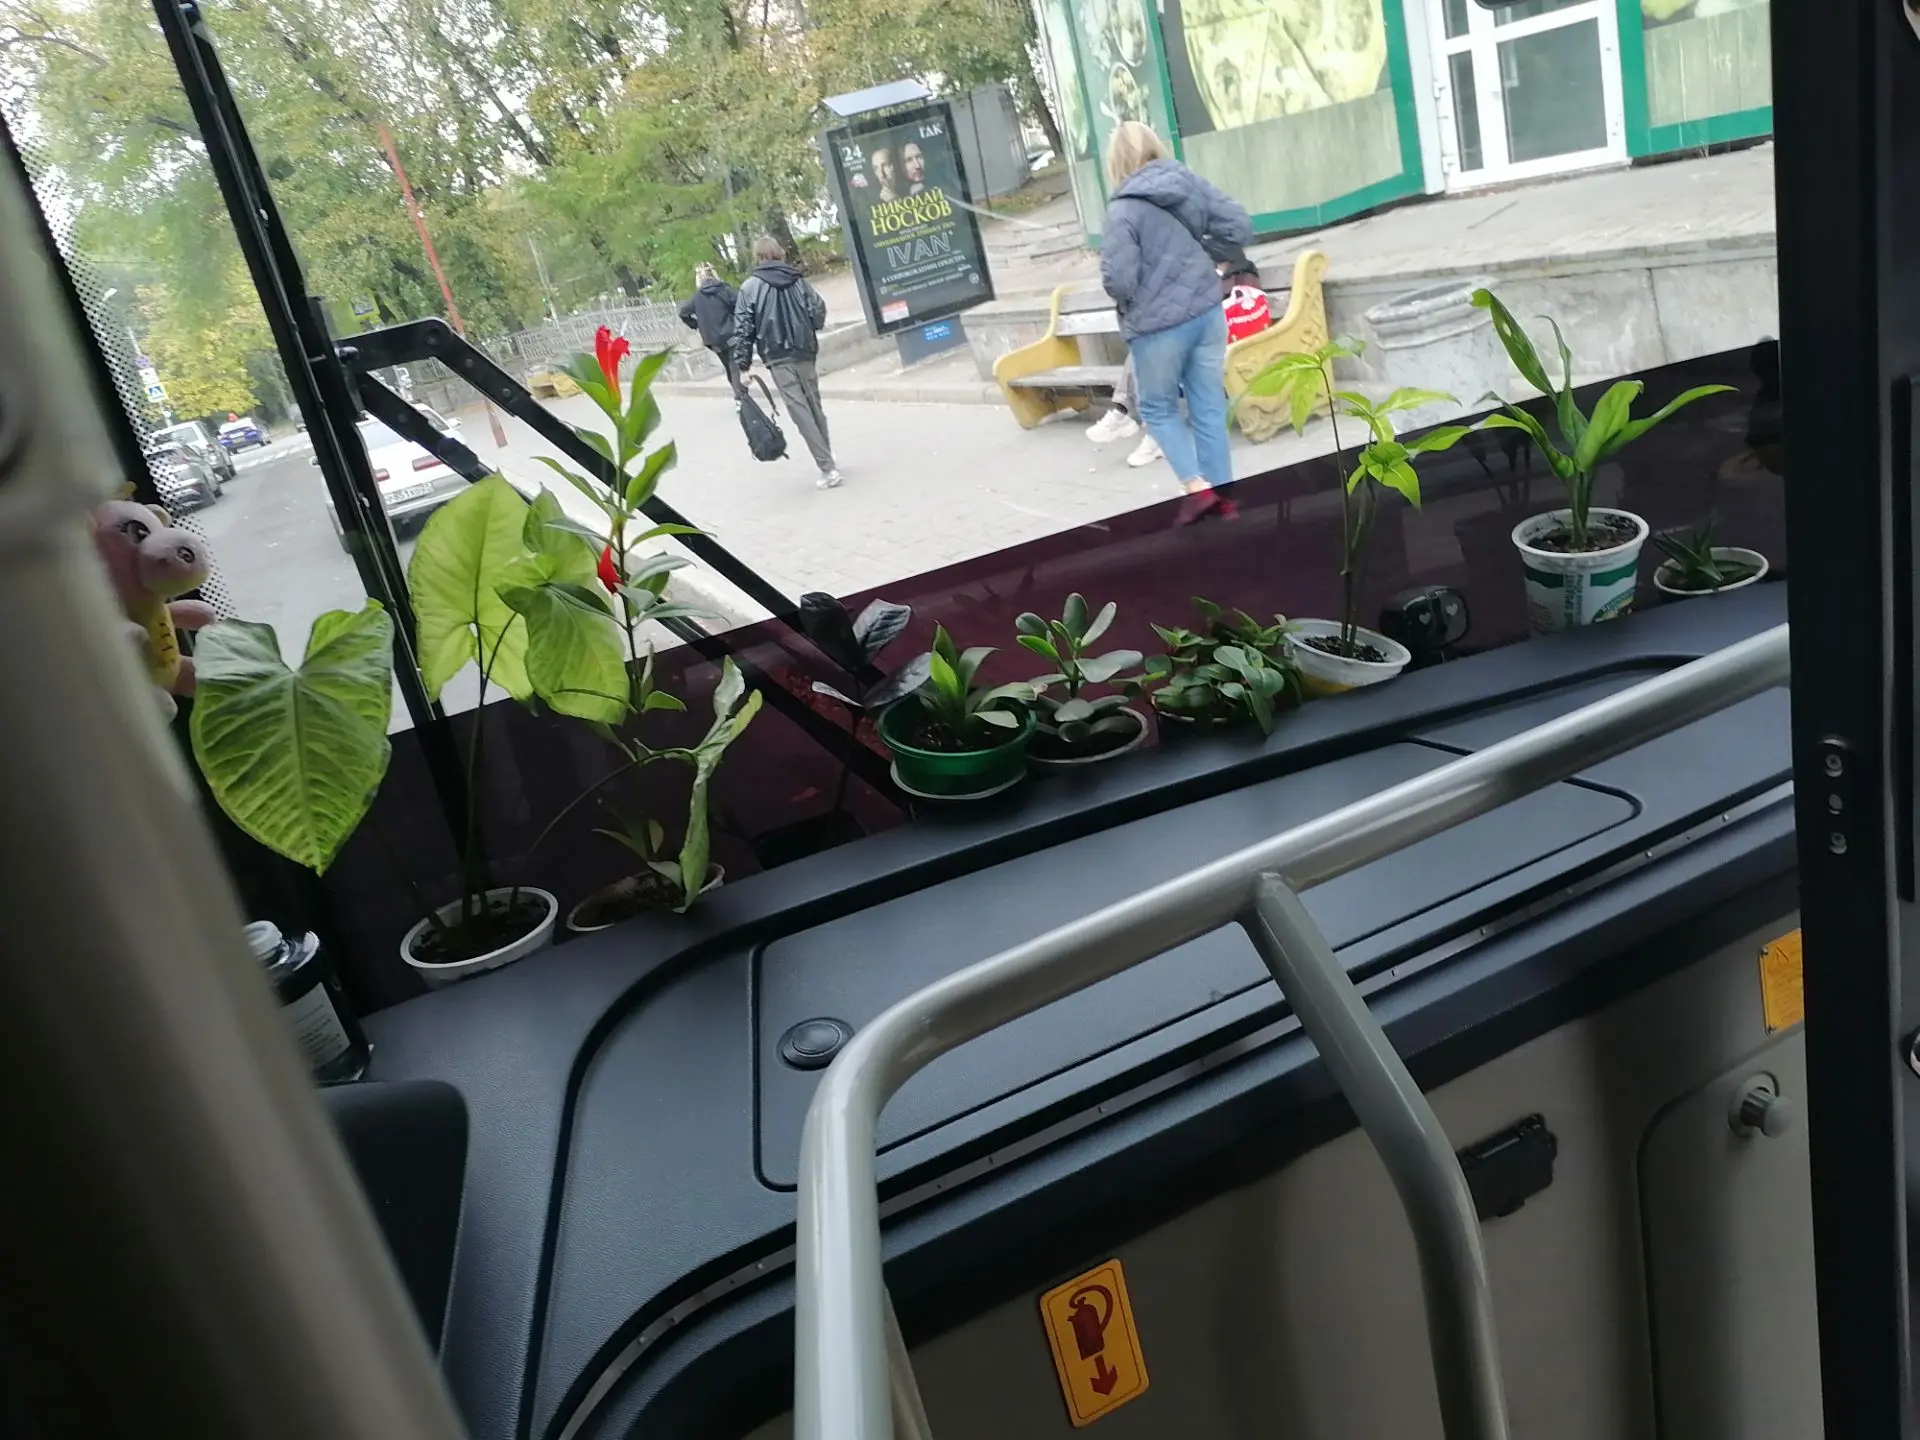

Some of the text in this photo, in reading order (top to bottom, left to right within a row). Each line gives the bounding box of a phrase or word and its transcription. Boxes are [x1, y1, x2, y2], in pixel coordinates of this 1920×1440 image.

[842, 144, 863, 161] 24
[870, 186, 945, 219] НИКОЛАЙ
[870, 200, 952, 236] НОСКОВ
[887, 232, 951, 268] IVAN
